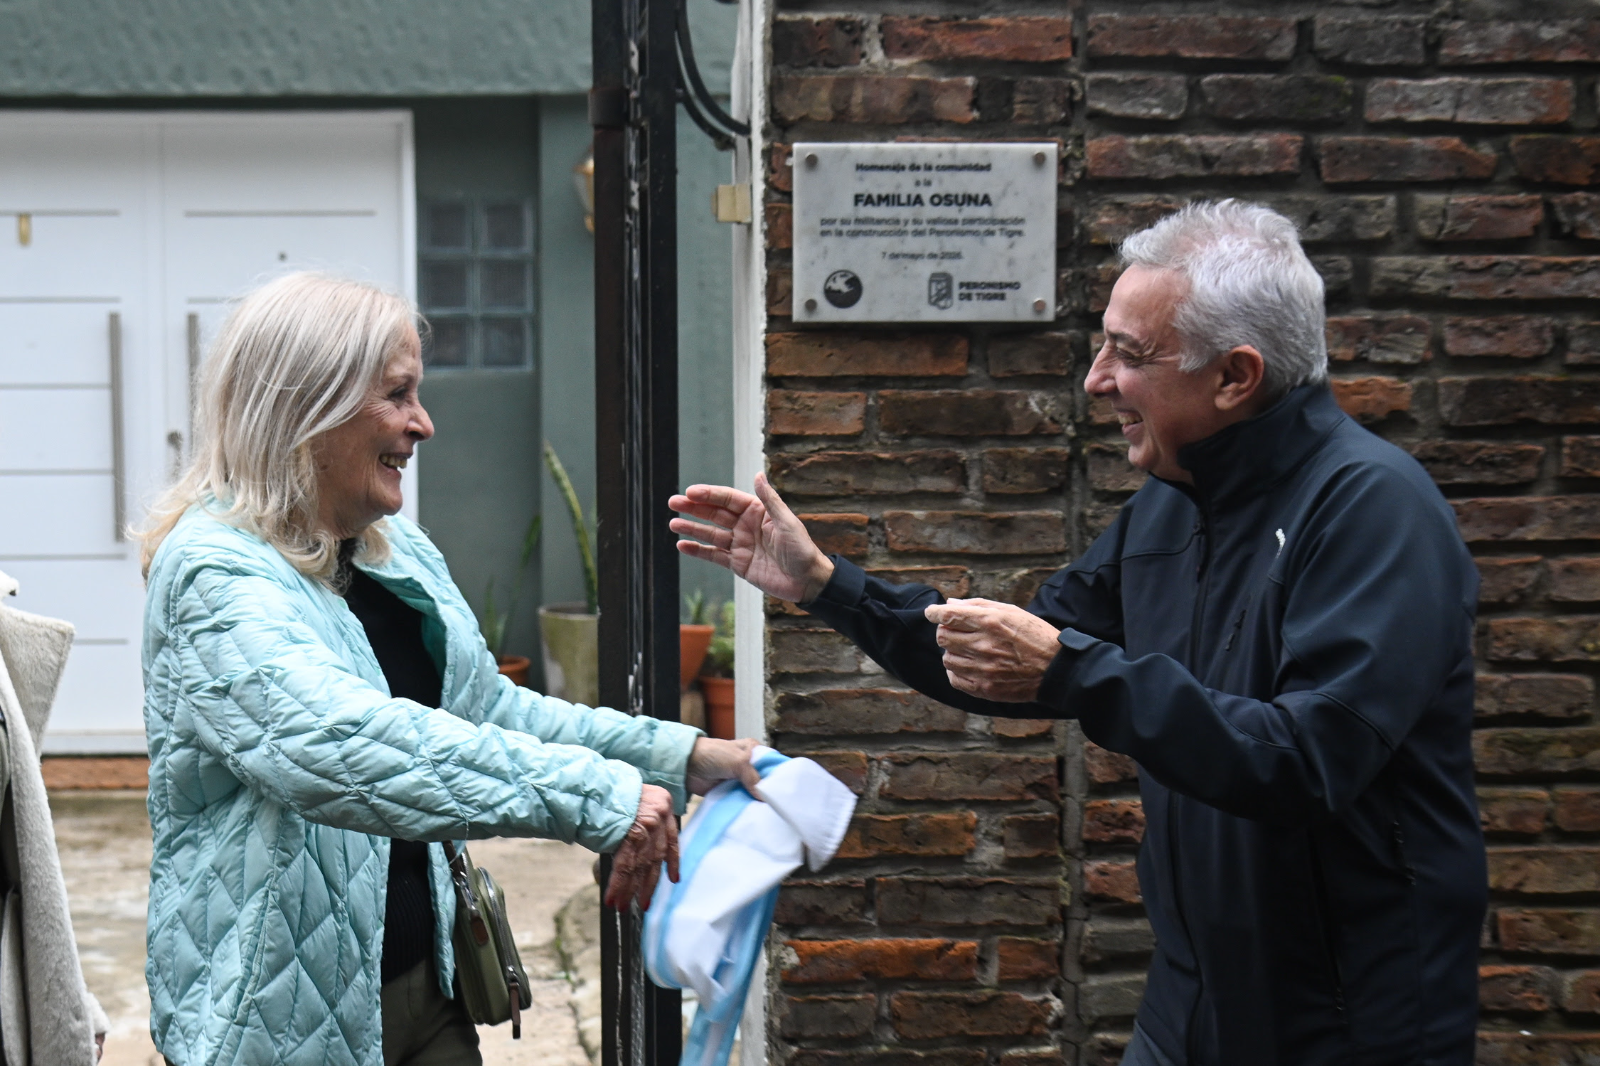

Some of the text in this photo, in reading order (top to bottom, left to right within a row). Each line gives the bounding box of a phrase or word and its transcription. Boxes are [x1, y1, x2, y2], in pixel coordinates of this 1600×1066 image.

[908, 163, 921, 172] de
[935, 163, 992, 172] comunidad
[854, 193, 992, 207] FAMILIA OSUNA
[958, 281, 1021, 290] PERONISMO
[958, 292, 1007, 301] DE TIGRE
